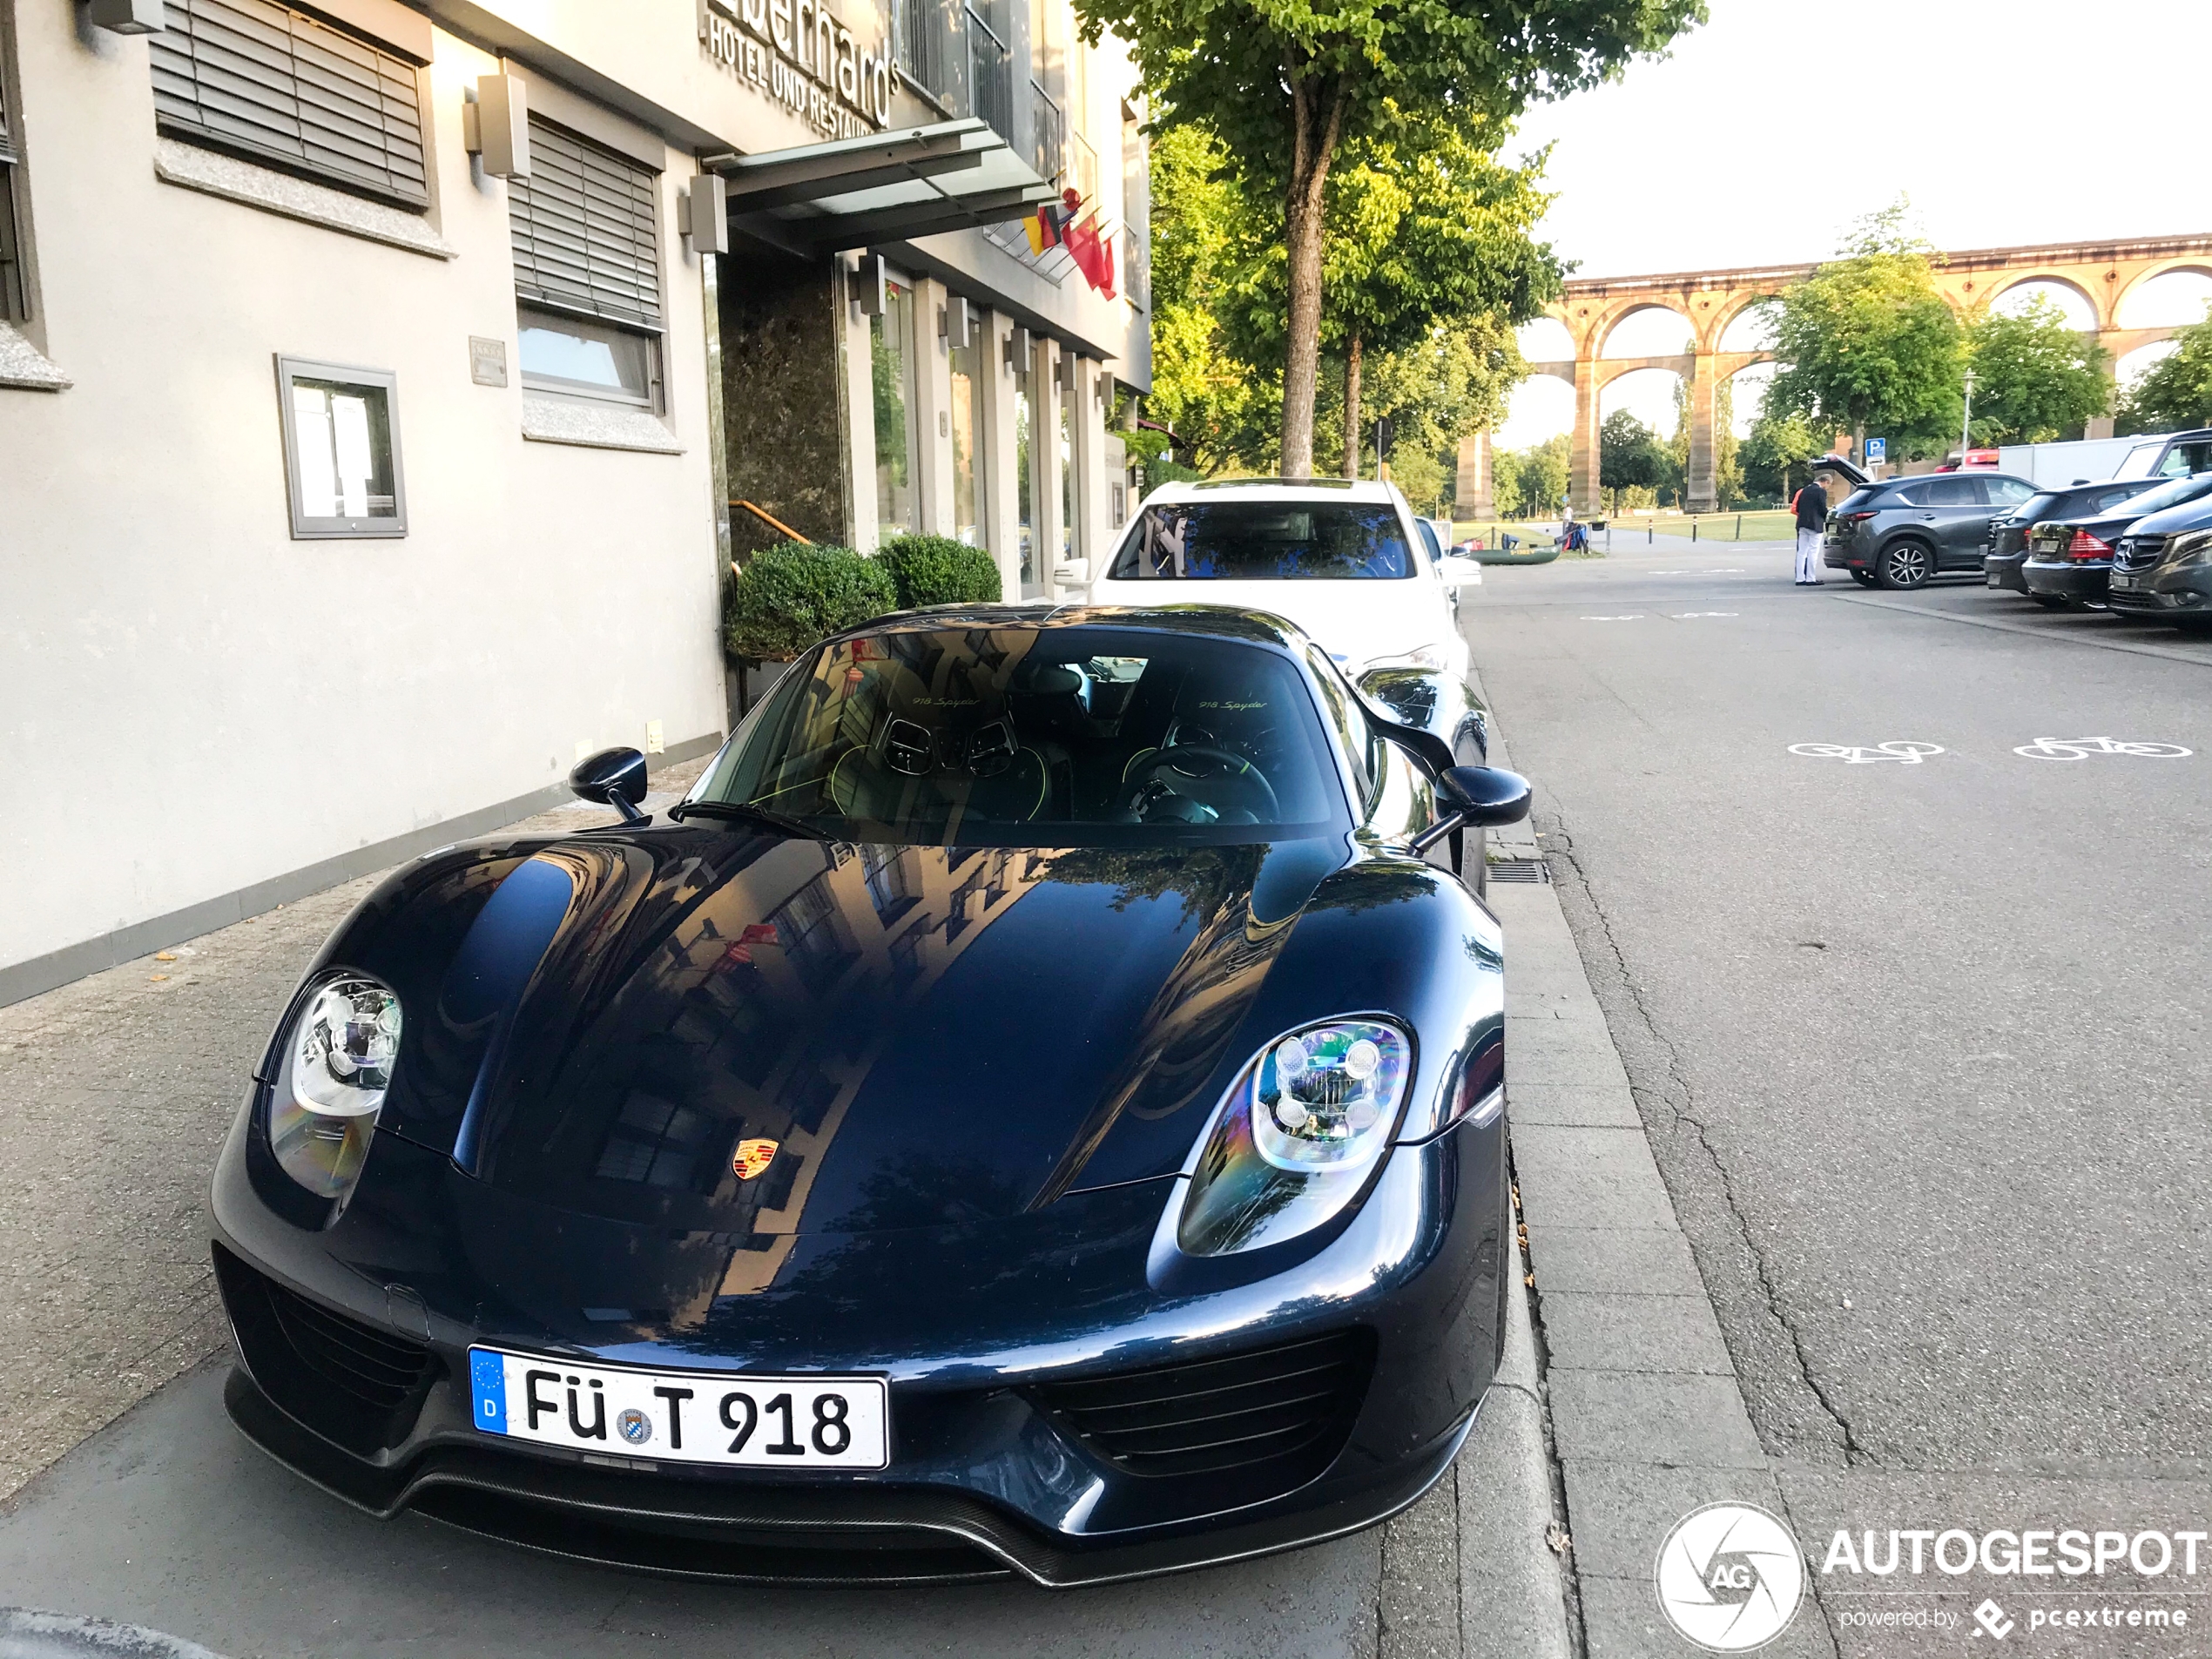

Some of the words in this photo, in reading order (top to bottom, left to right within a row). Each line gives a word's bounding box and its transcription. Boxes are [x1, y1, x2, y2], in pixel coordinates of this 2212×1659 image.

[710, 14, 767, 88] HOTEL
[772, 58, 806, 112] UND
[1870, 441, 1881, 455] P
[933, 697, 980, 708] Spyder
[1220, 701, 1267, 711] Spyder
[484, 1399, 496, 1417] D
[653, 1386, 694, 1449] T
[719, 1392, 851, 1455] 918
